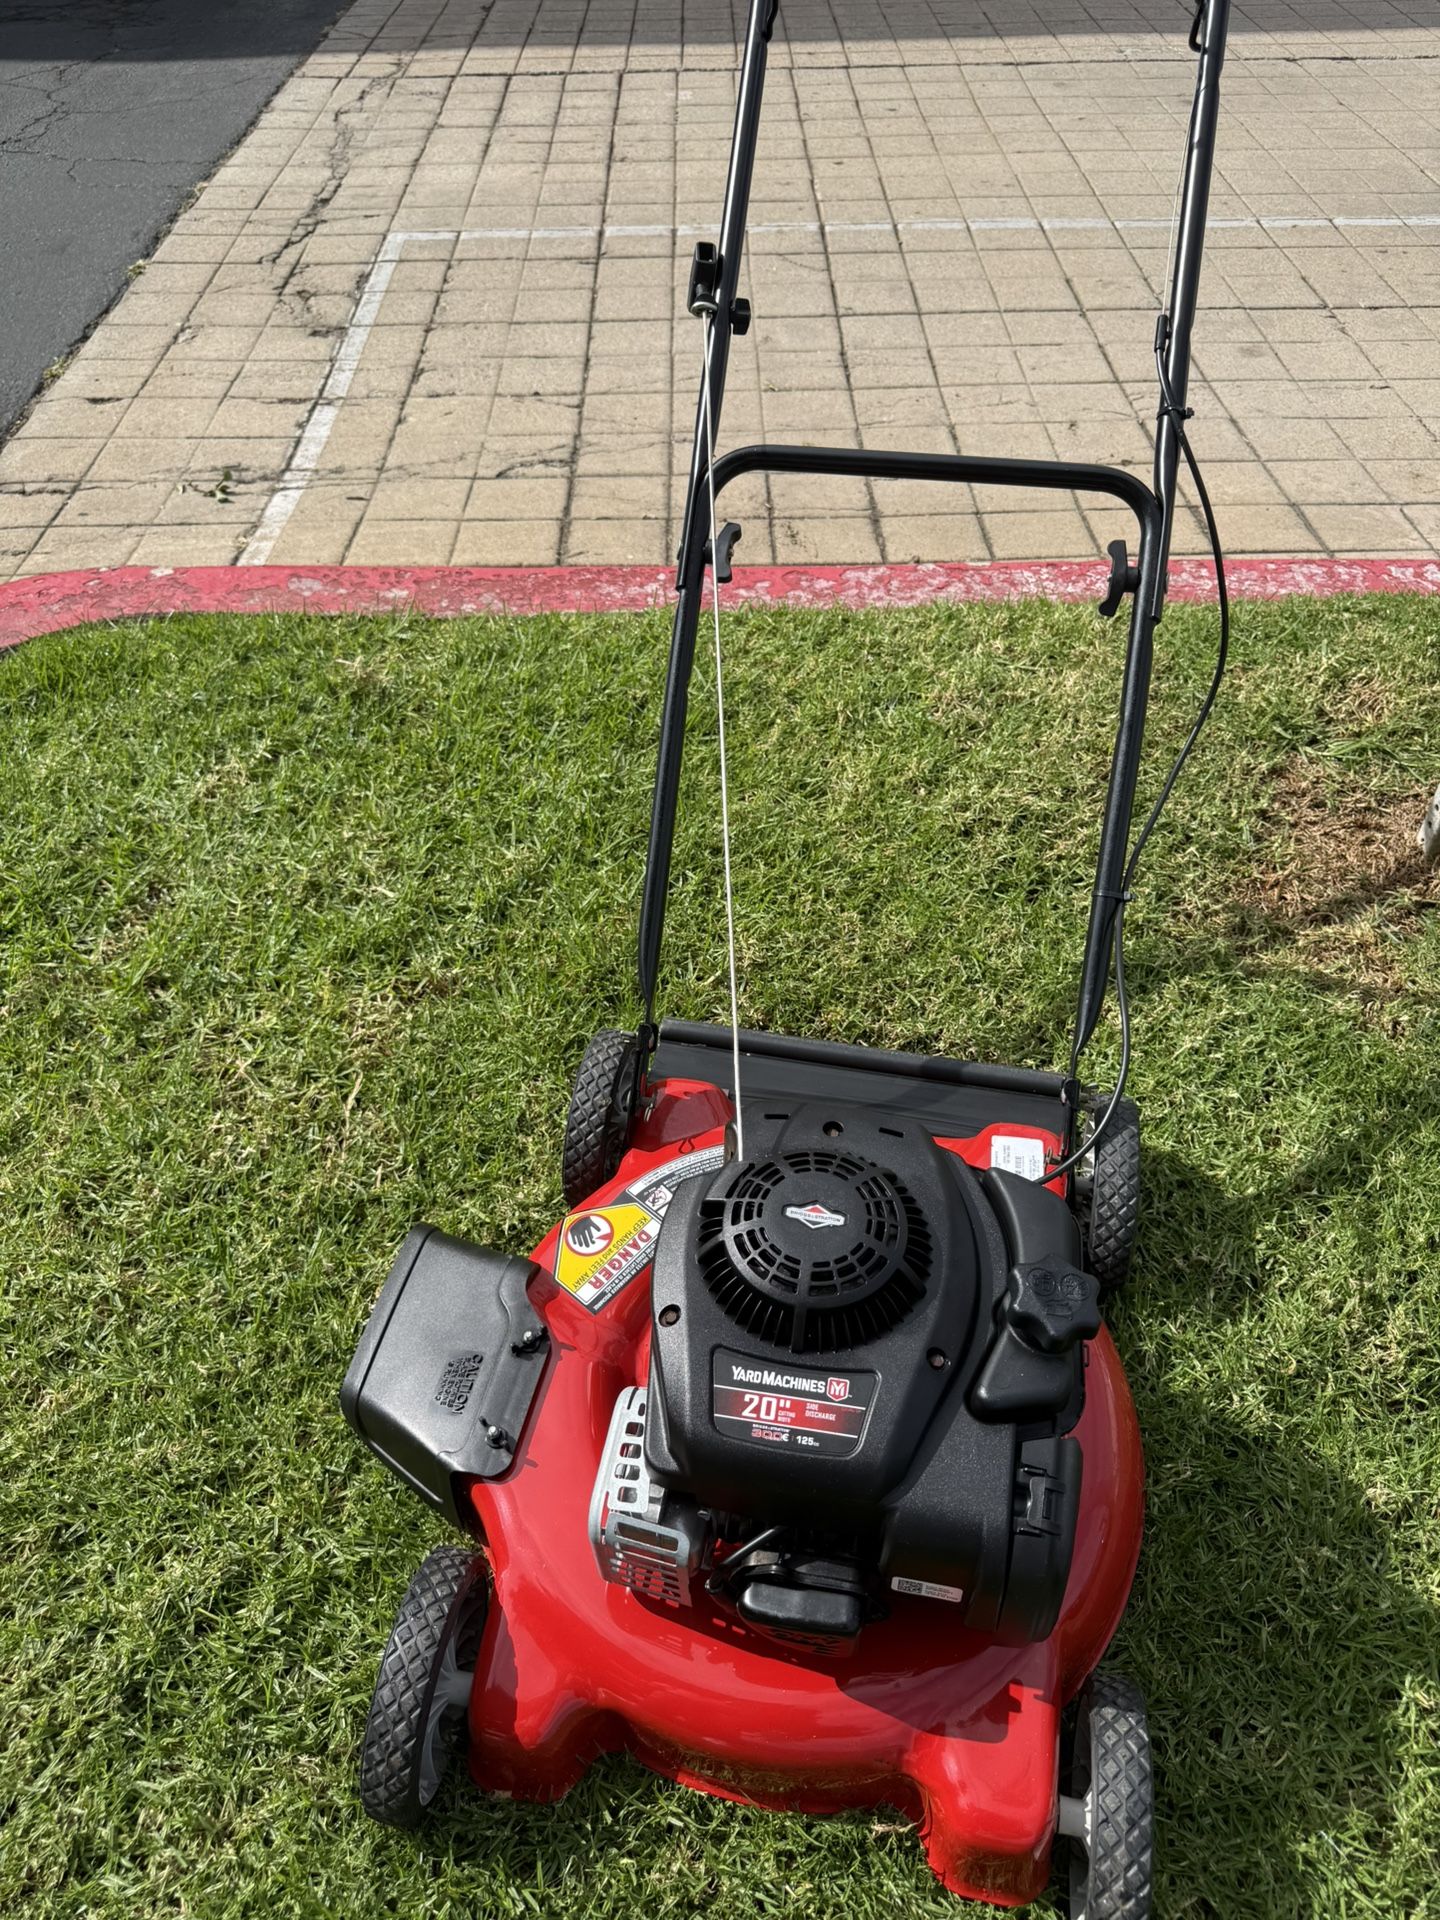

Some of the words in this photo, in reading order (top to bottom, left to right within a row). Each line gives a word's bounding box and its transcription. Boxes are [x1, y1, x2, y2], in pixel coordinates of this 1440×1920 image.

[633, 1215, 648, 1232] KEEP
[612, 1230, 633, 1250] HANDS
[587, 1229, 652, 1290] DANGER
[603, 1248, 614, 1260] and
[588, 1256, 605, 1272] FEET
[572, 1271, 590, 1289] AWAY
[451, 1354, 484, 1415] CAUTION
[732, 1366, 762, 1383] YARD
[762, 1370, 825, 1393] MACHINES
[742, 1394, 791, 1421] 20"
[805, 1410, 836, 1421] DISCHARGE
[806, 1403, 819, 1411] SIDE
